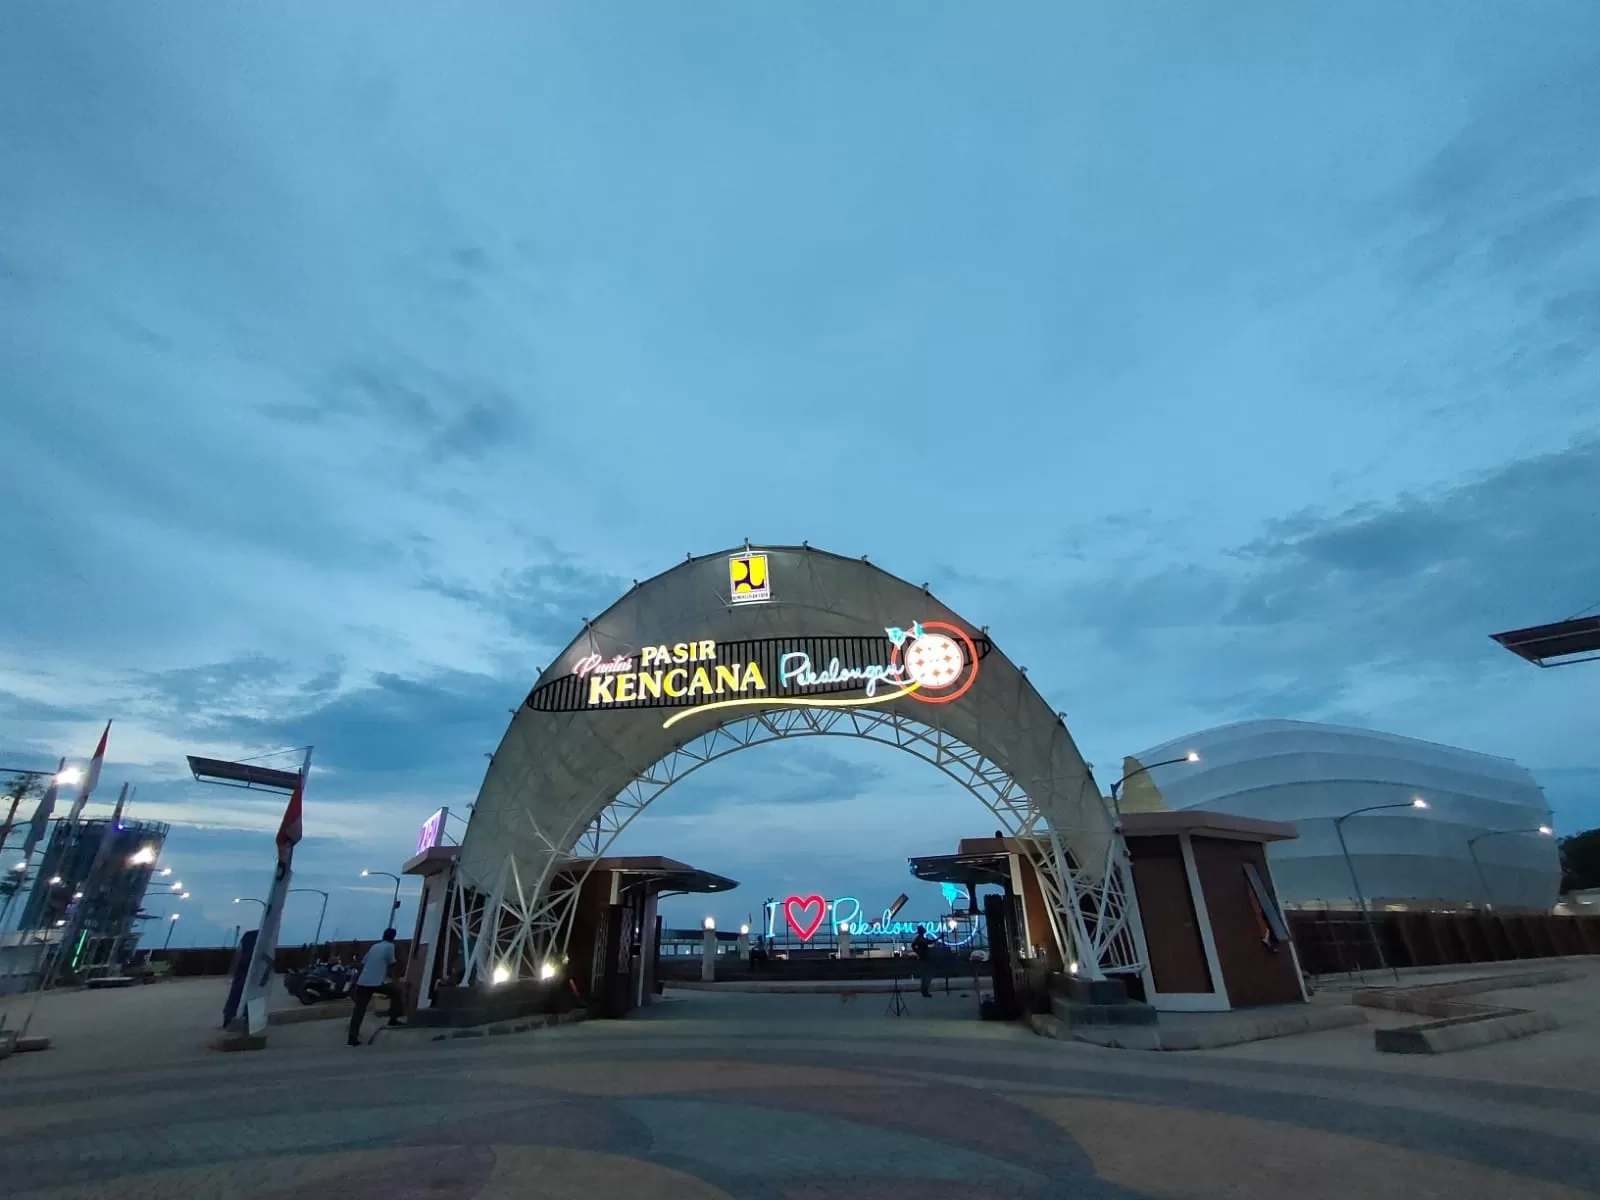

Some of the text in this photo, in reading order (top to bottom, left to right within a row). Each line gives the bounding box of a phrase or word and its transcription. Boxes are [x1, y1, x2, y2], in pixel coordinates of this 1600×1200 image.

[641, 640, 717, 666] PASIR
[587, 662, 767, 705] KENCANA
[765, 901, 781, 939] I
